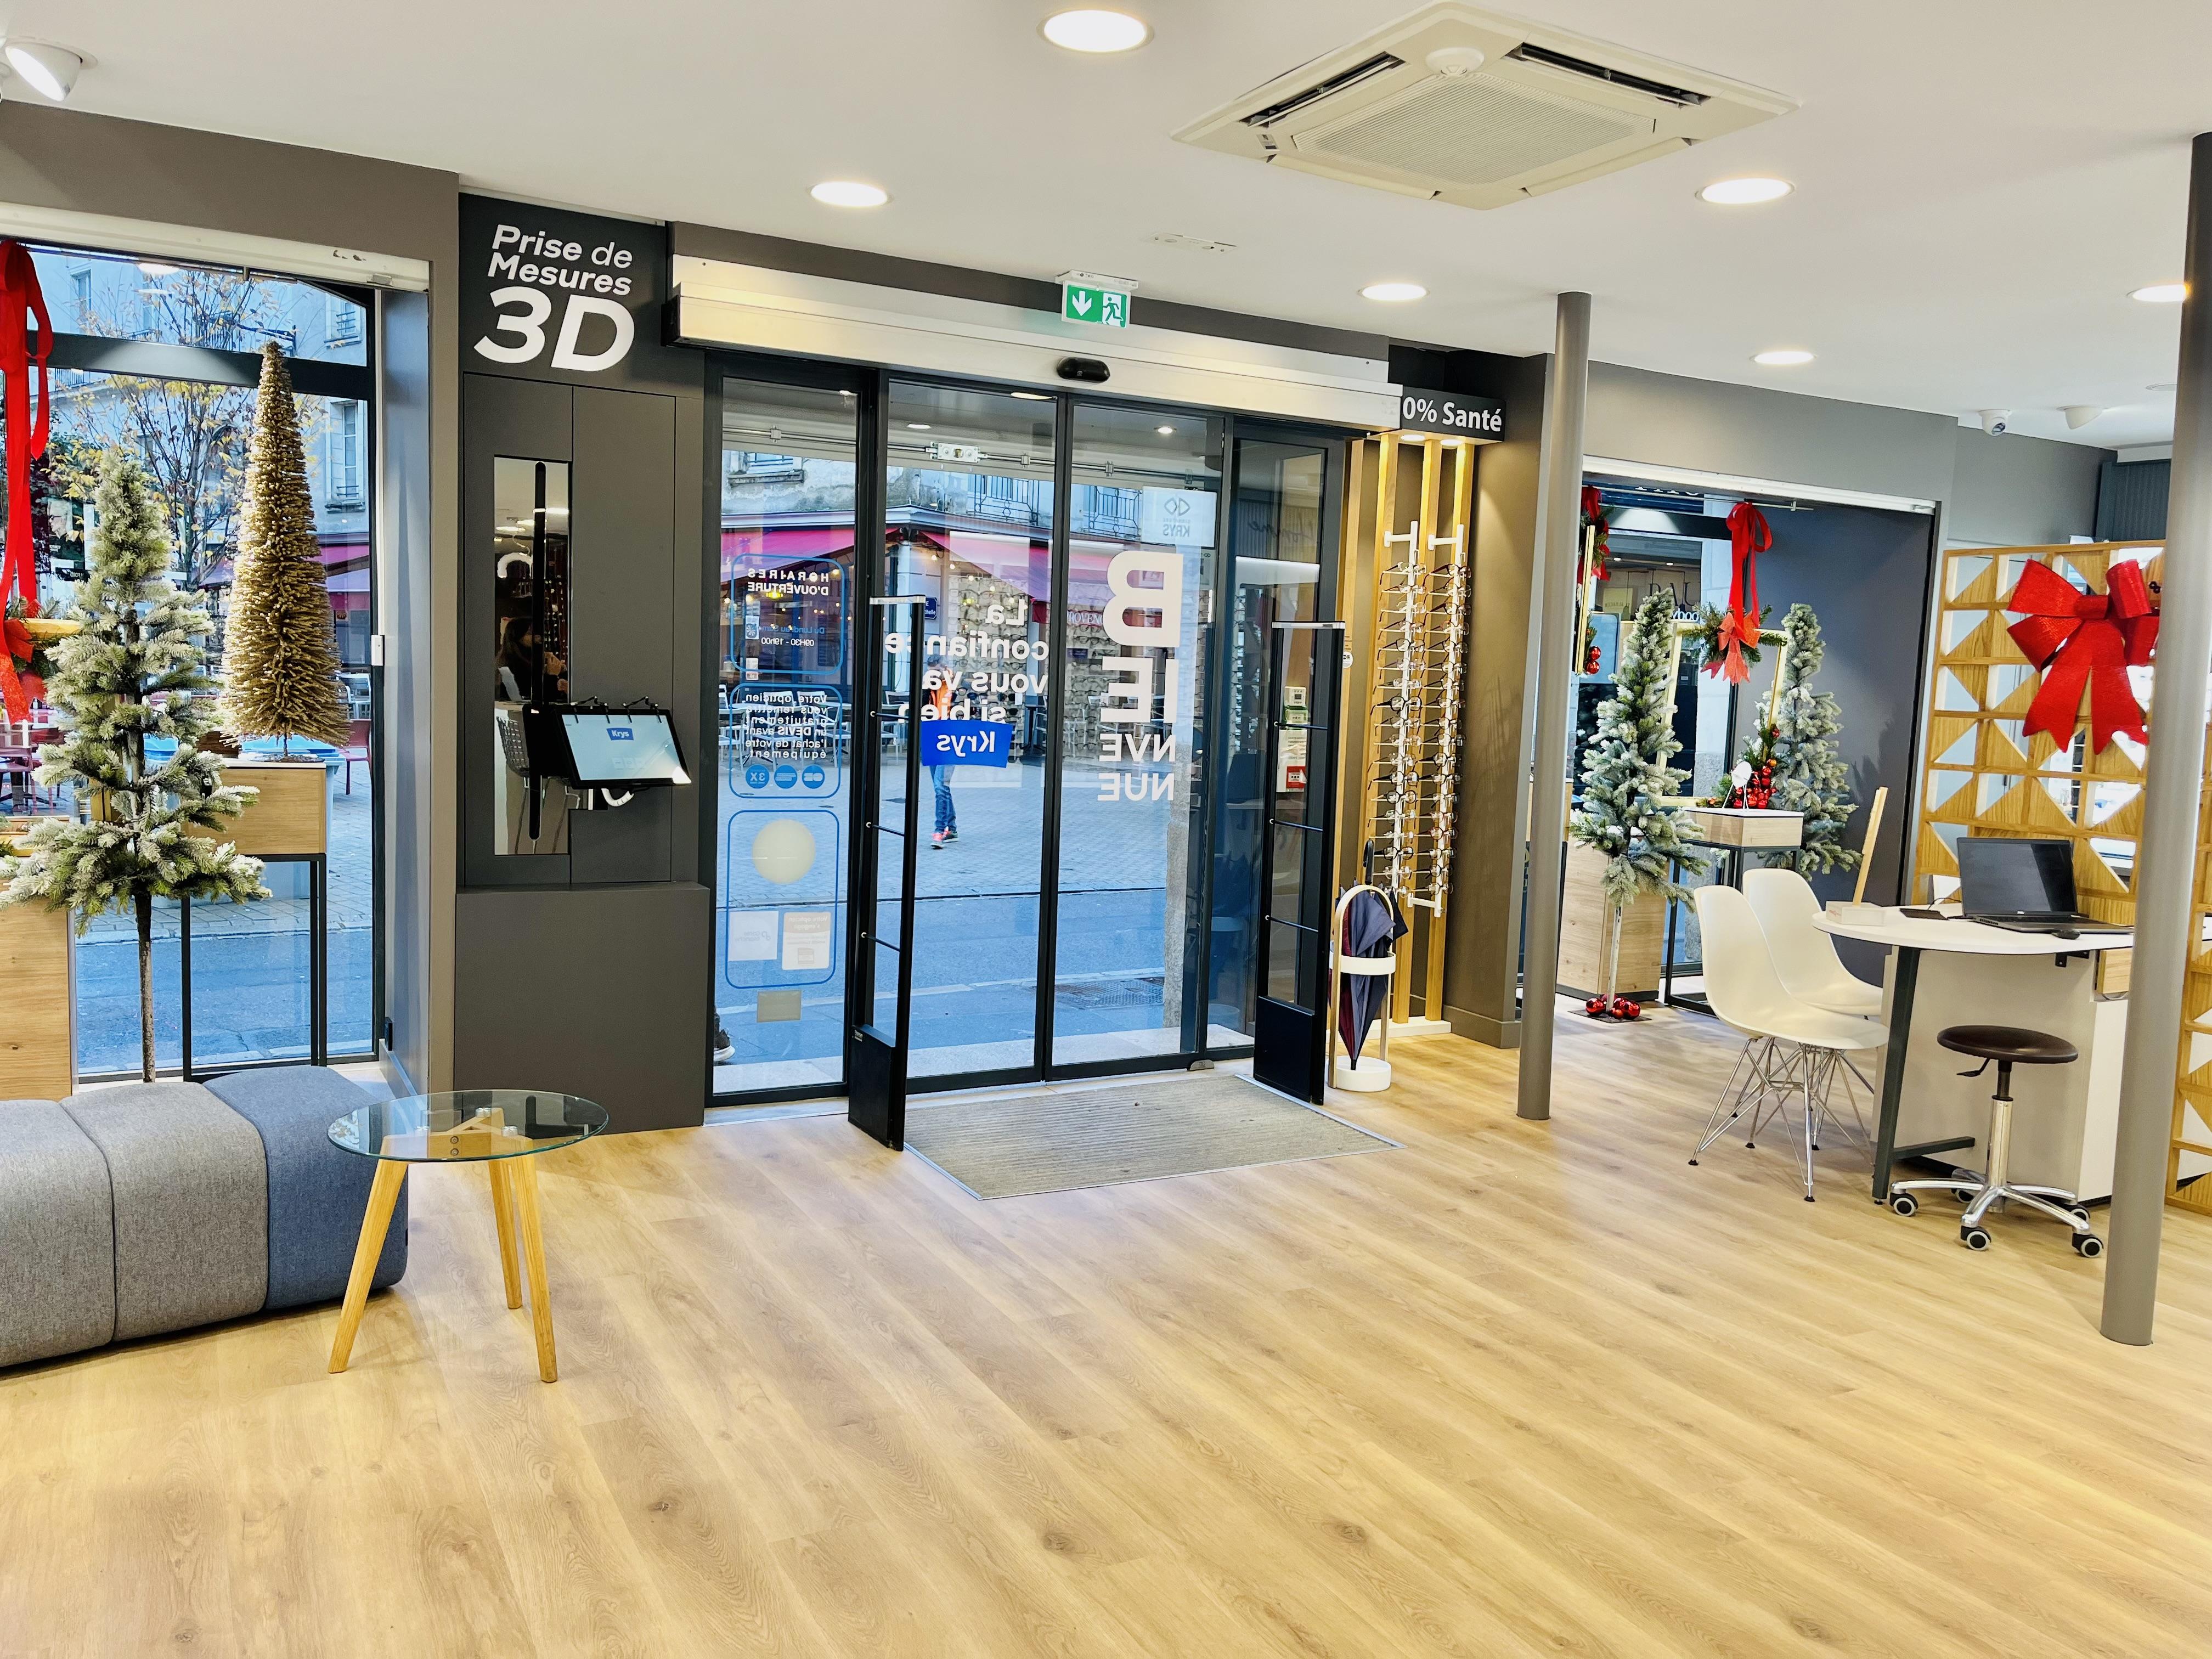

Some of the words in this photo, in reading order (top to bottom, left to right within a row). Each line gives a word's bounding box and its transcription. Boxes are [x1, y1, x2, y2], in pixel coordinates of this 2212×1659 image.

[492, 224, 582, 261] Prise
[591, 242, 633, 268] de
[488, 252, 632, 296] Mesures
[474, 286, 635, 371] 3D
[1442, 402, 1502, 432] Santé
[611, 730, 630, 738] Krys
